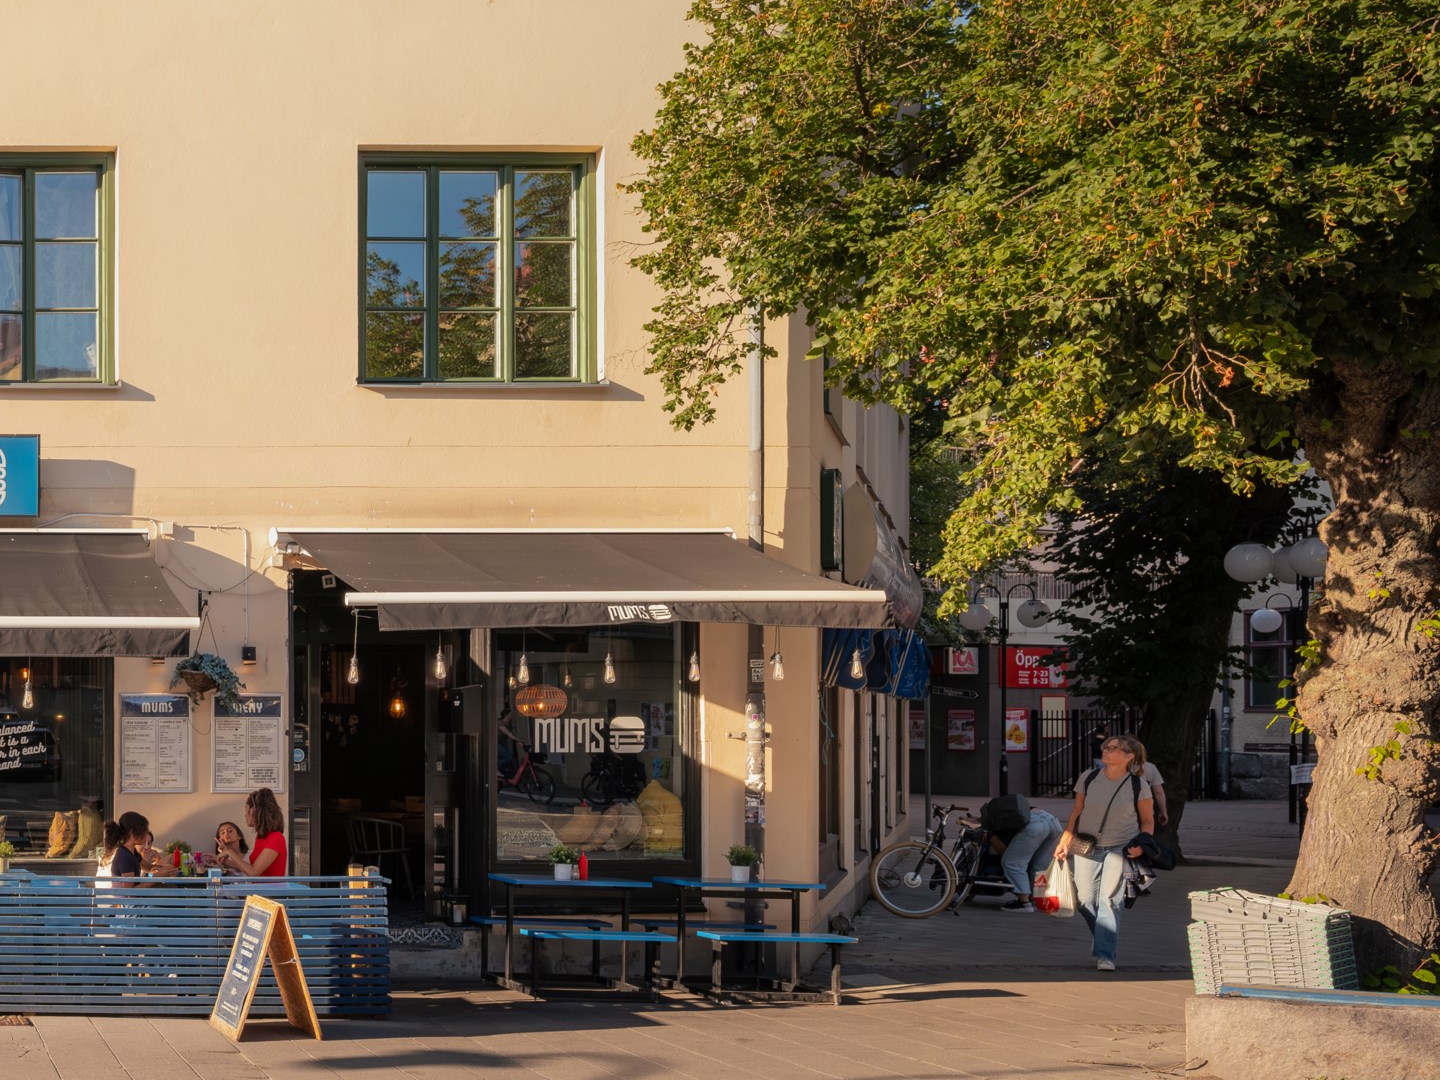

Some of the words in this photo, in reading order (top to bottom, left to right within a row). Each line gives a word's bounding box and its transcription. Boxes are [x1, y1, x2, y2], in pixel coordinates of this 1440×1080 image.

[607, 605, 650, 621] MUMS
[141, 702, 173, 713] MUMS
[7, 735, 19, 747] is
[20, 736, 30, 745] a
[534, 718, 605, 753] MUMS
[8, 746, 21, 758] in
[22, 742, 47, 755] each
